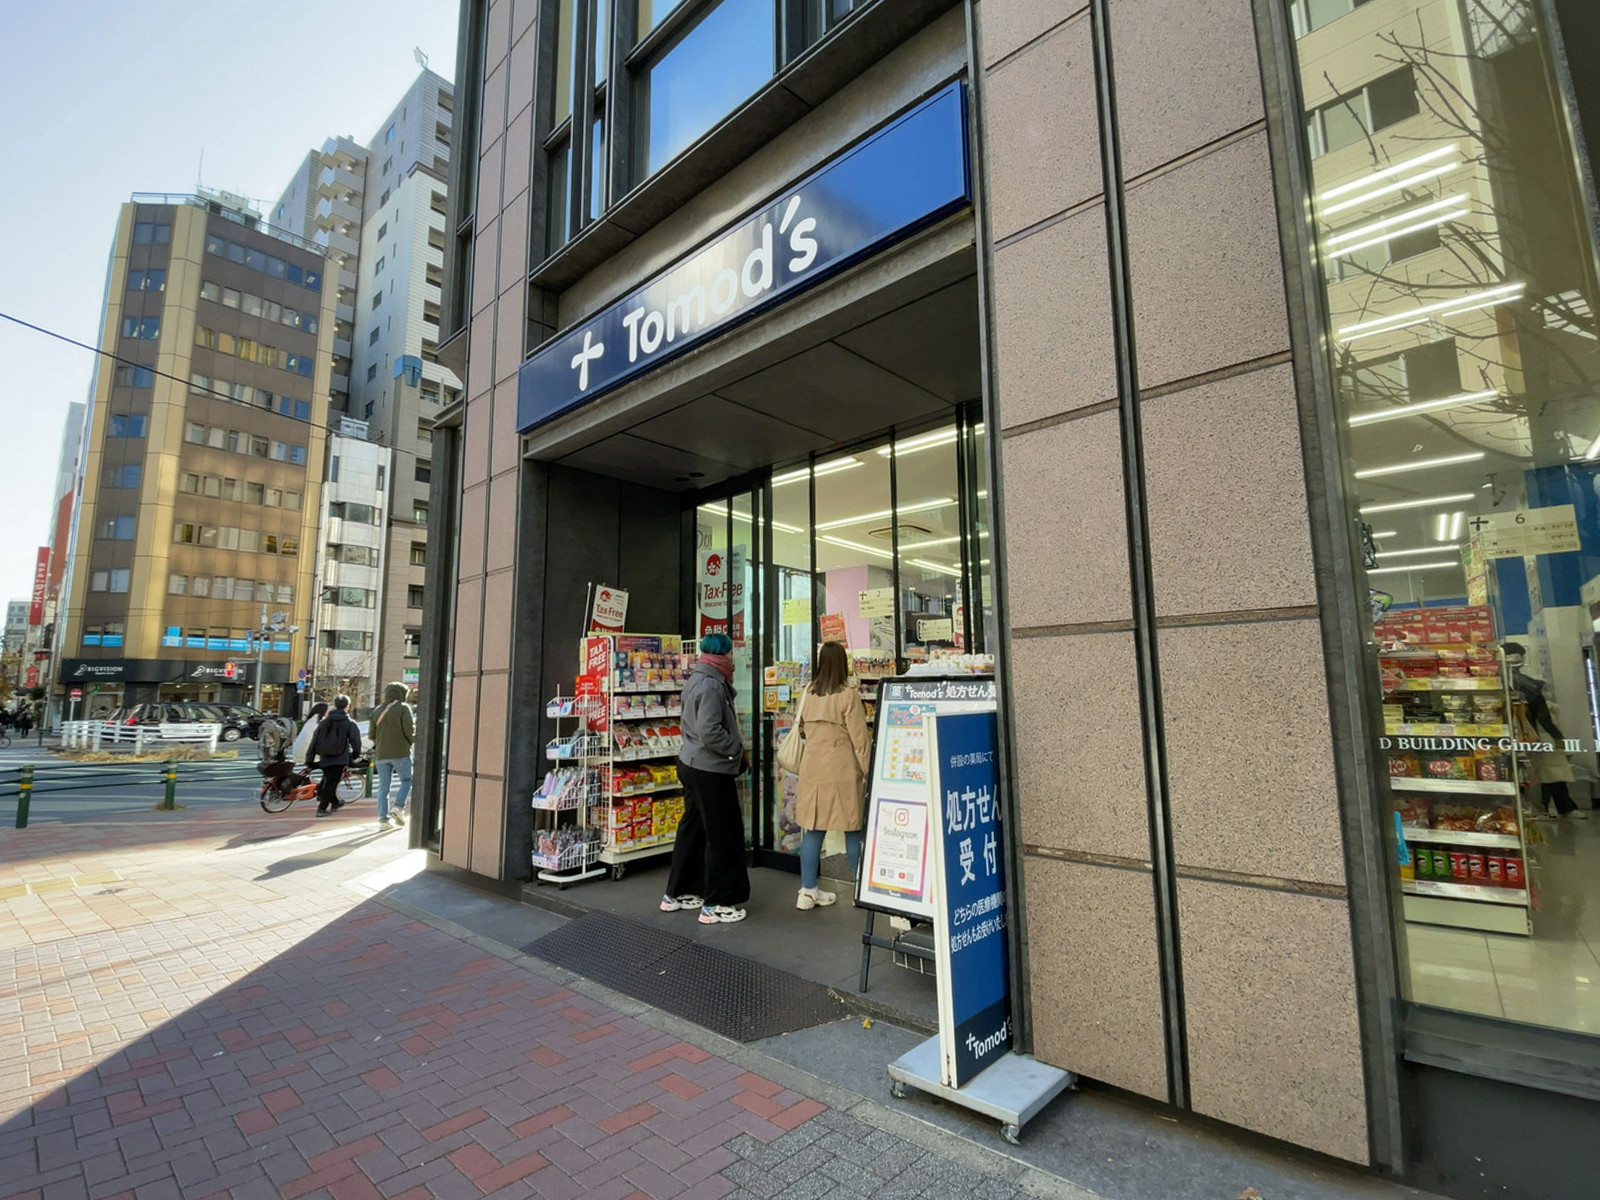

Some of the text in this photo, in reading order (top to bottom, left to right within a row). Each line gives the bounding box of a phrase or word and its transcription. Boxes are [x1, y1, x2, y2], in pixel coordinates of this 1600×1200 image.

[623, 195, 818, 363] Tomod's
[1515, 513, 1525, 524] 6
[704, 582, 743, 600] Tax-Fee
[596, 603, 624, 618] Tax-Free
[589, 643, 603, 657] TAX
[588, 651, 606, 669] FREE
[909, 686, 944, 699] Tomod's
[1398, 737, 1491, 751] BUILDING
[1497, 738, 1553, 752] Ginza
[946, 783, 1002, 835] 処方せん
[884, 825, 919, 842] Instagram
[973, 1016, 1013, 1060] Tomod's
